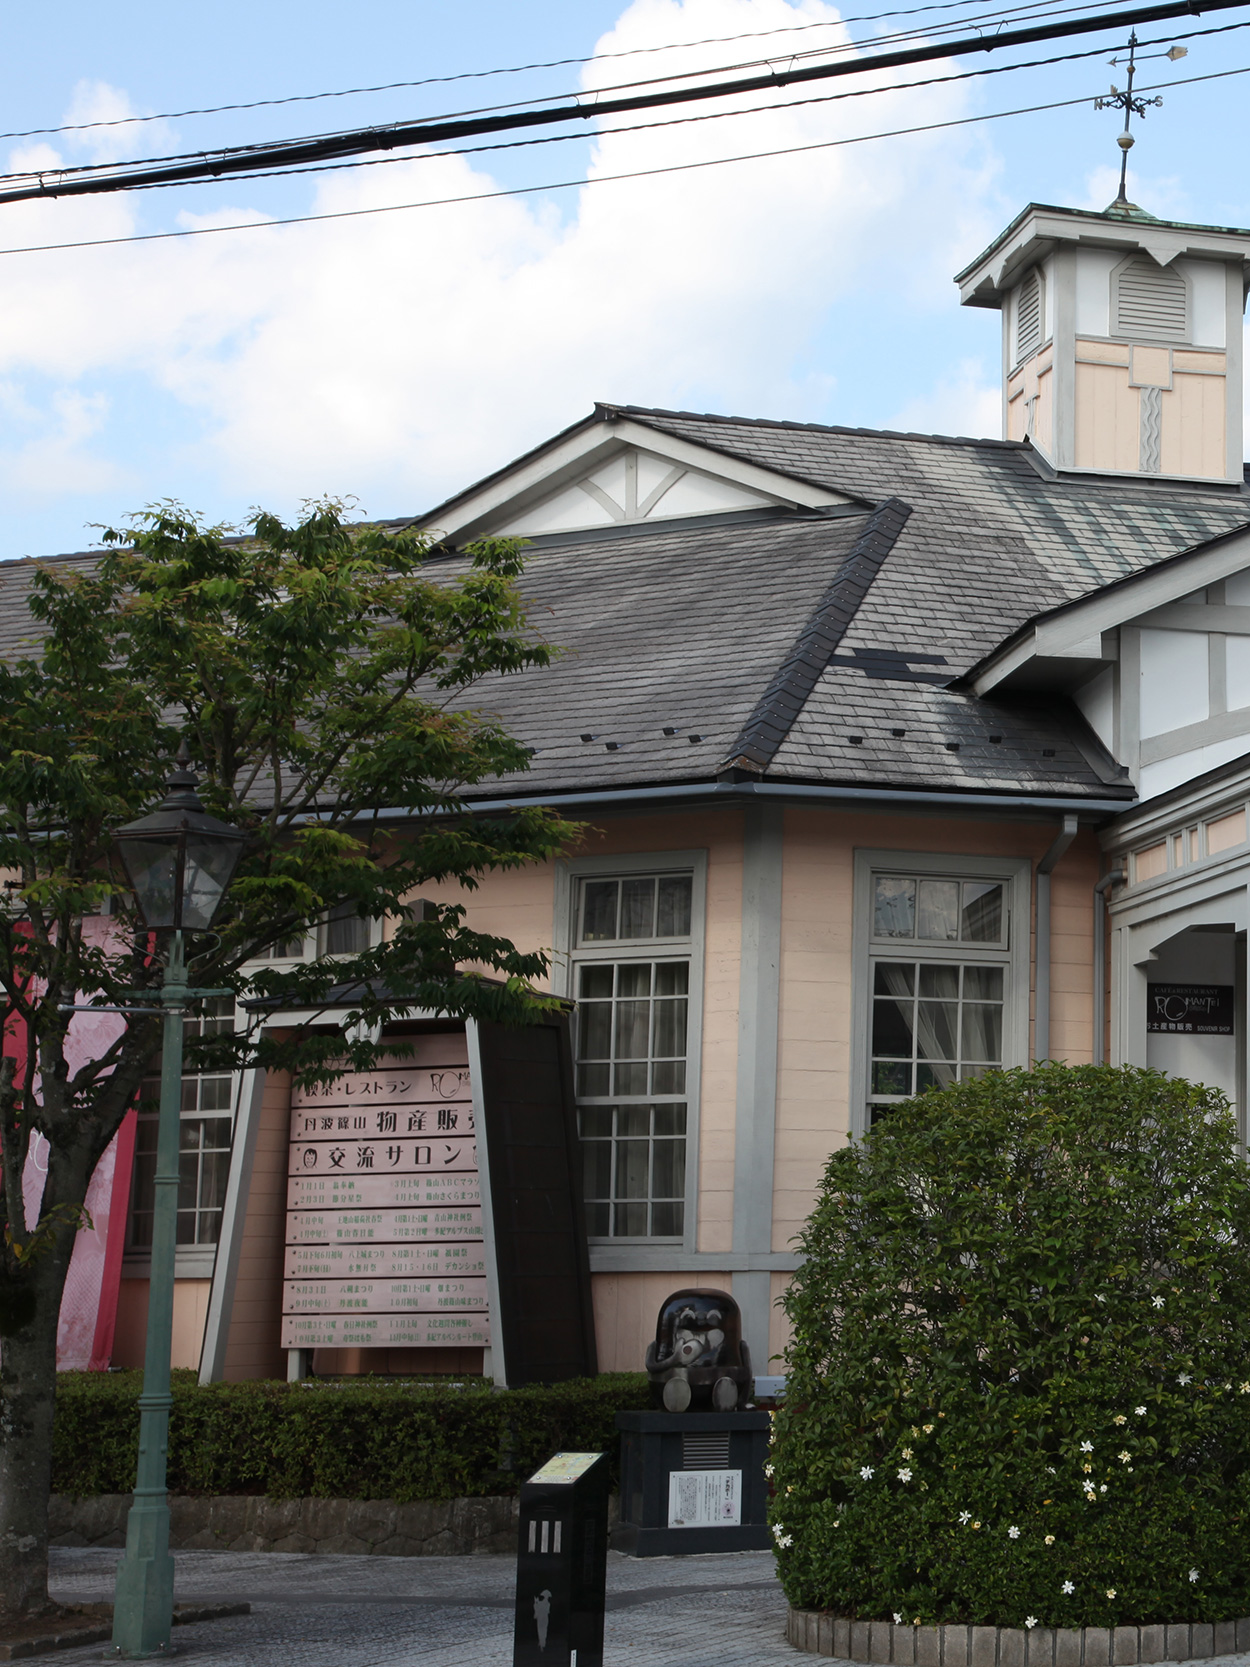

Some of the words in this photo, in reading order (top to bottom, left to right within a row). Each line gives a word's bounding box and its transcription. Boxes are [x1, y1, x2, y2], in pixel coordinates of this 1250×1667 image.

[1155, 95, 1163, 108] S
[305, 1117, 367, 1131] 丹波篠山
[328, 1145, 462, 1169] 交流サロン
[301, 1181, 325, 1190] 1月1日
[394, 1179, 419, 1188] 3月上旬
[300, 1195, 325, 1204] 2月3日
[426, 1191, 480, 1200] 篠山さくらまつり
[349, 1250, 385, 1259] 八上城まつり
[445, 1261, 485, 1270] デカンショ祭
[296, 1285, 326, 1294] 8月31日
